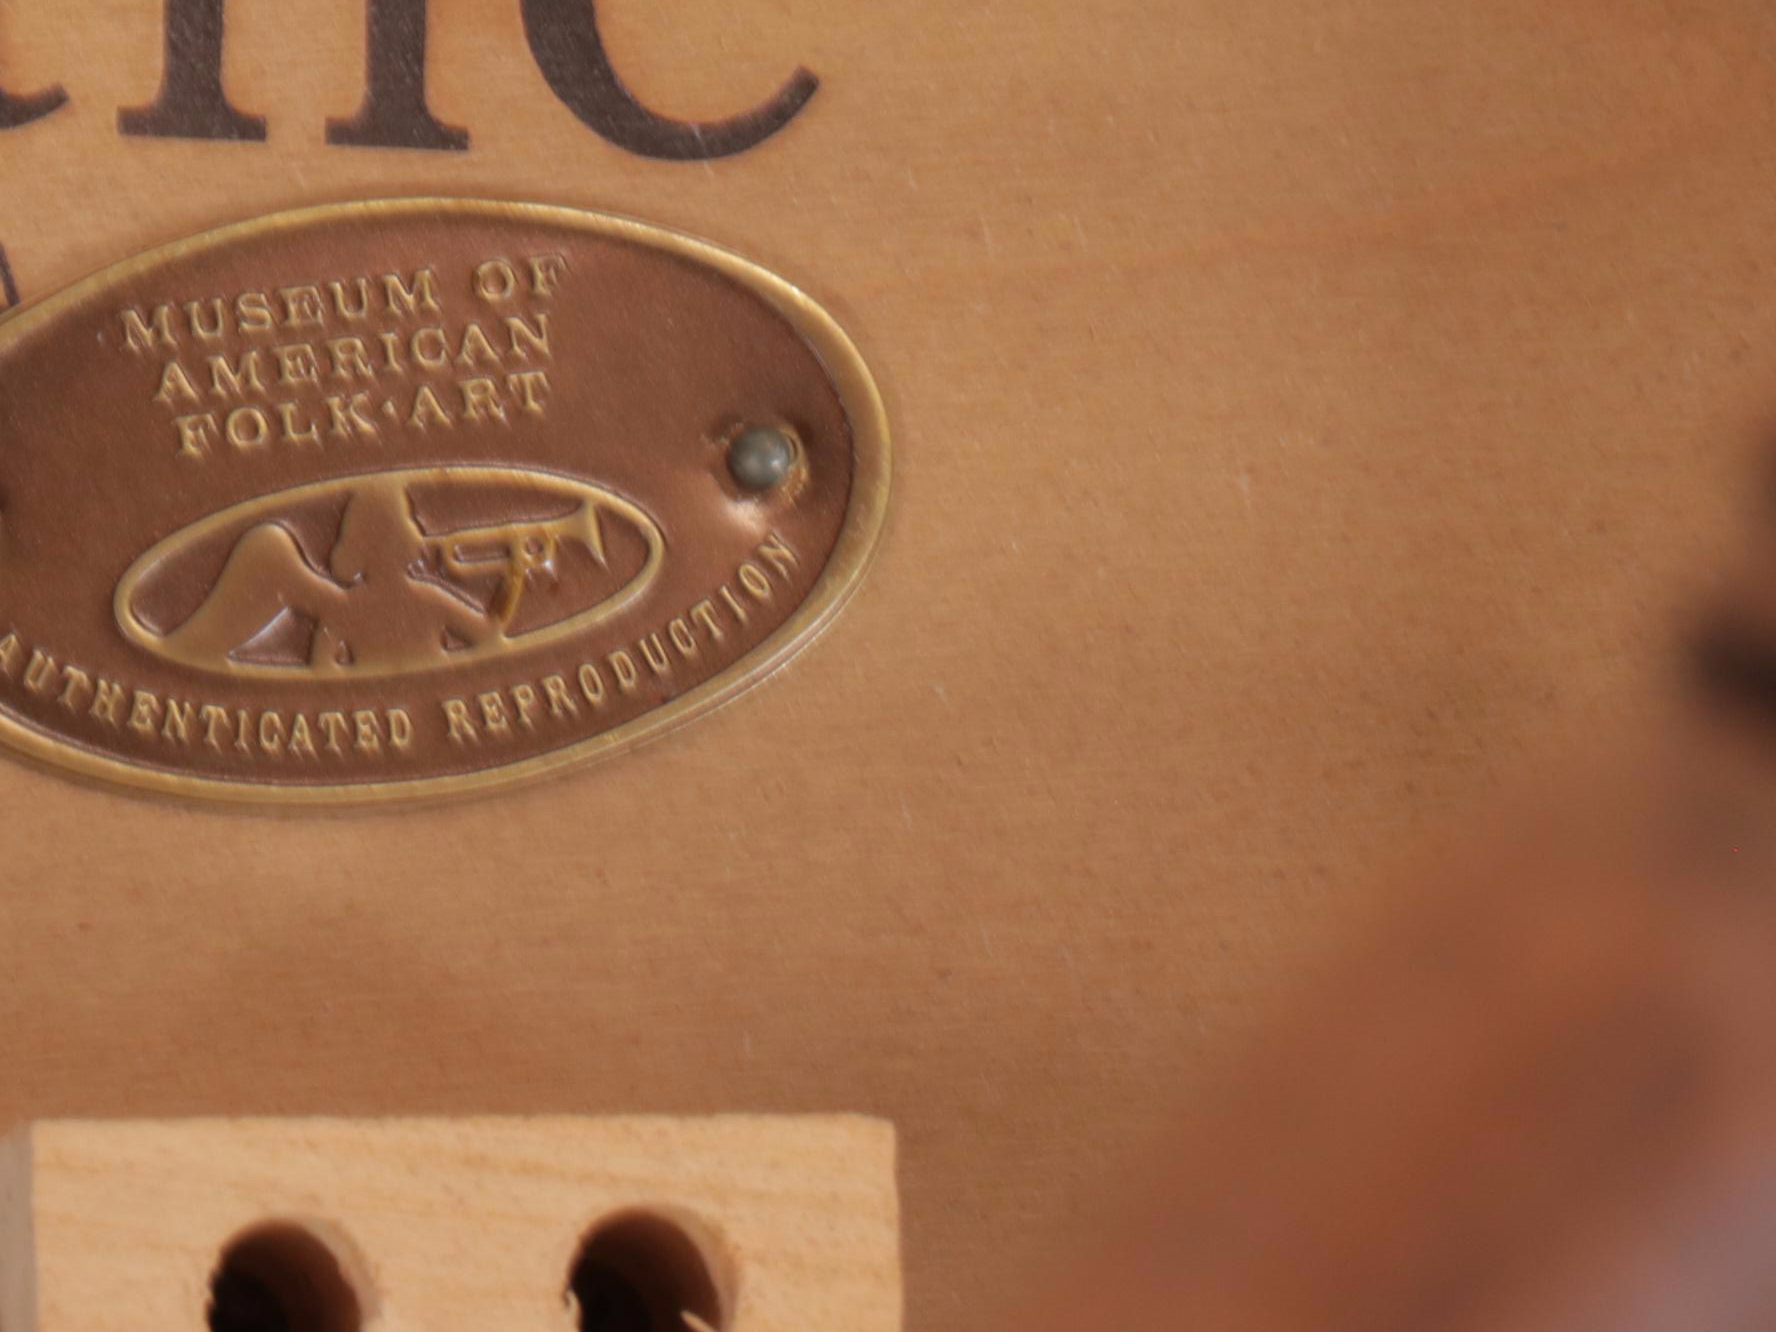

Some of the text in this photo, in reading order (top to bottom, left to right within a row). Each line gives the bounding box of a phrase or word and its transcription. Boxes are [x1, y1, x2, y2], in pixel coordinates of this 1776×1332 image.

[120, 253, 569, 352] MUSEUM OF
[153, 313, 555, 405] AMERICAN
[441, 532, 801, 742] REPRODUCTION
